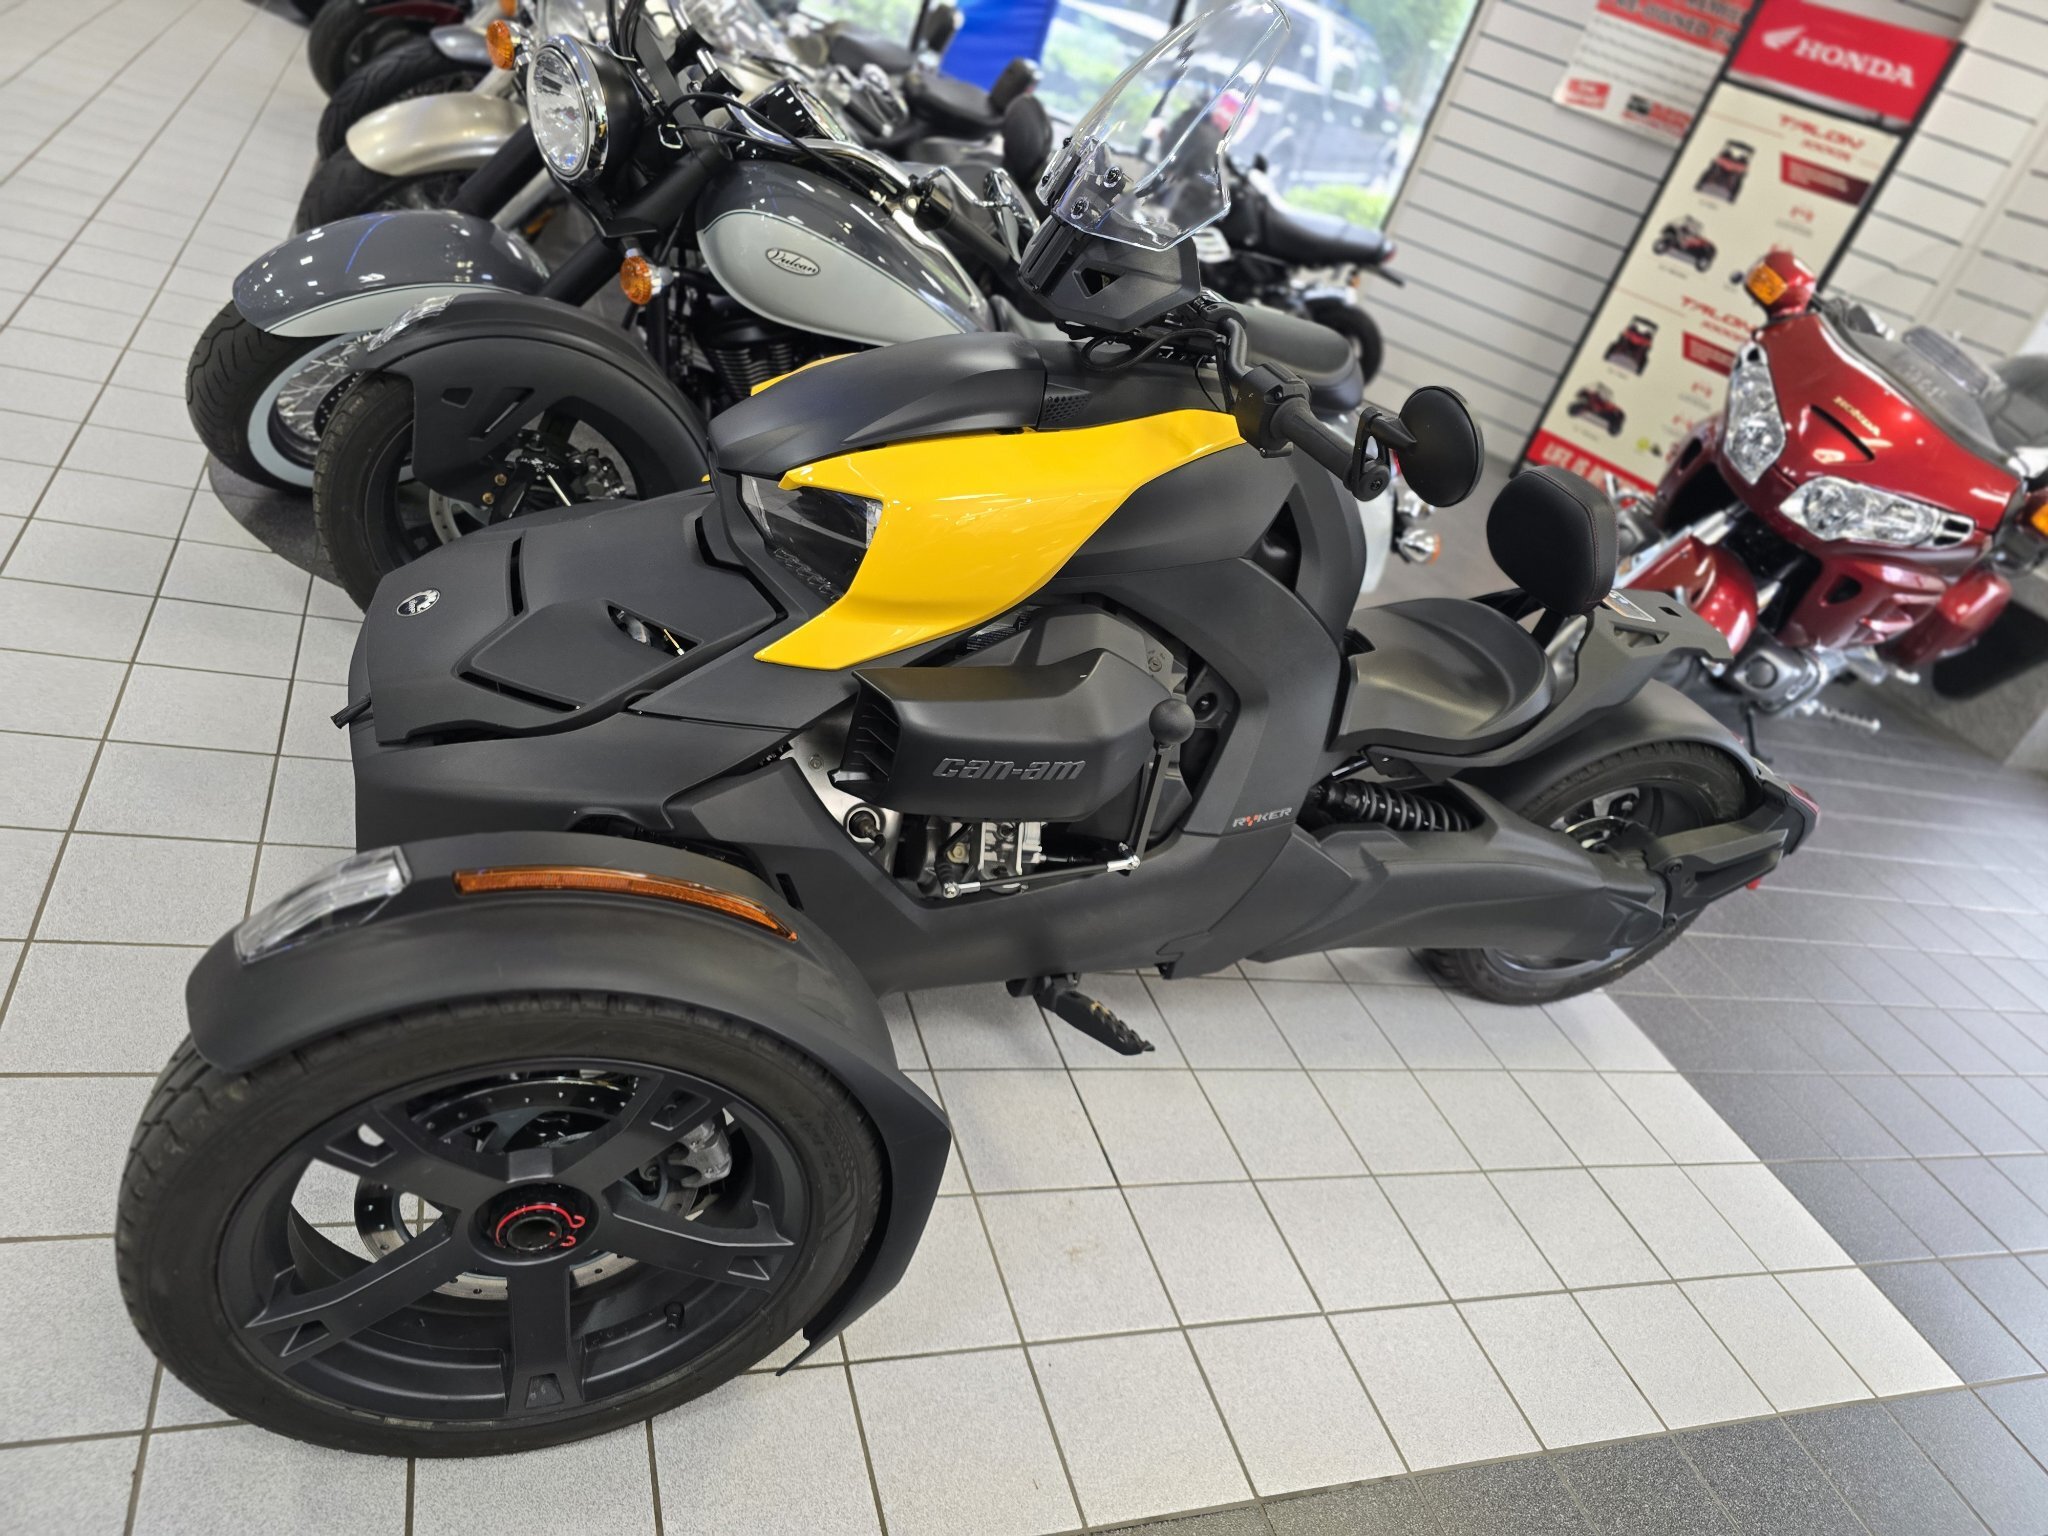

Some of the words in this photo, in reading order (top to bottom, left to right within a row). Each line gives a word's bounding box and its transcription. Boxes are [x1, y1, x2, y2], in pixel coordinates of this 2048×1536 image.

[1793, 37, 1915, 89] HONDA
[1778, 113, 1865, 151] TALON
[769, 248, 817, 273] Vulcan
[1232, 807, 1293, 828] RYKER
